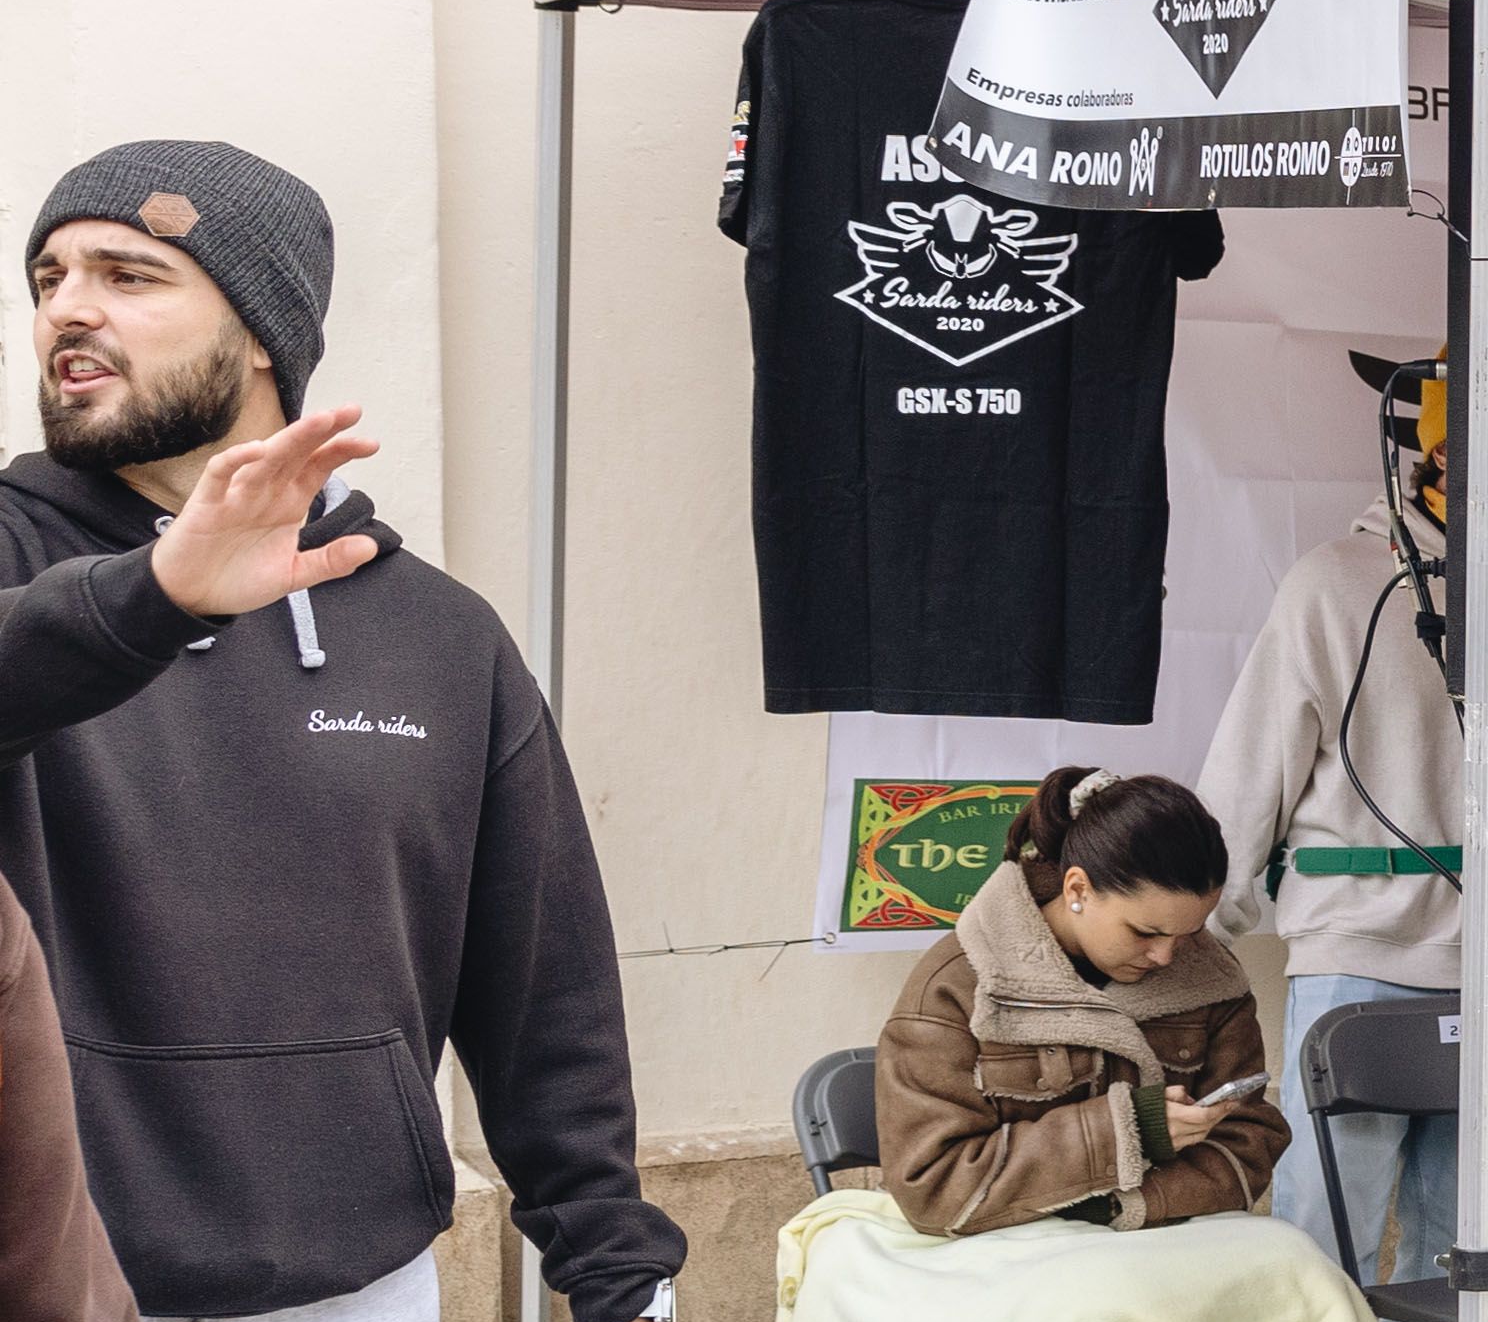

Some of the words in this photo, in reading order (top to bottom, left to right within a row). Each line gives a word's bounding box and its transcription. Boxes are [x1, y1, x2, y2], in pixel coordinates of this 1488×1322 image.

[1202, 32, 1229, 55] 2020
[966, 67, 1064, 107] Empresas
[1066, 89, 1134, 108] colaboradoras
[942, 120, 1039, 179] ANA
[1049, 150, 1123, 186] ROMO
[1200, 143, 1272, 178] ROTULOS
[1274, 140, 1331, 176] ROMO
[880, 277, 962, 310] Sarda
[966, 283, 1038, 314] riders
[936, 316, 985, 331] 2020
[897, 387, 975, 415] GSX-S
[977, 388, 1022, 415] 750
[308, 709, 374, 732] Sarda
[378, 715, 428, 738] riders
[938, 803, 981, 824] BAR
